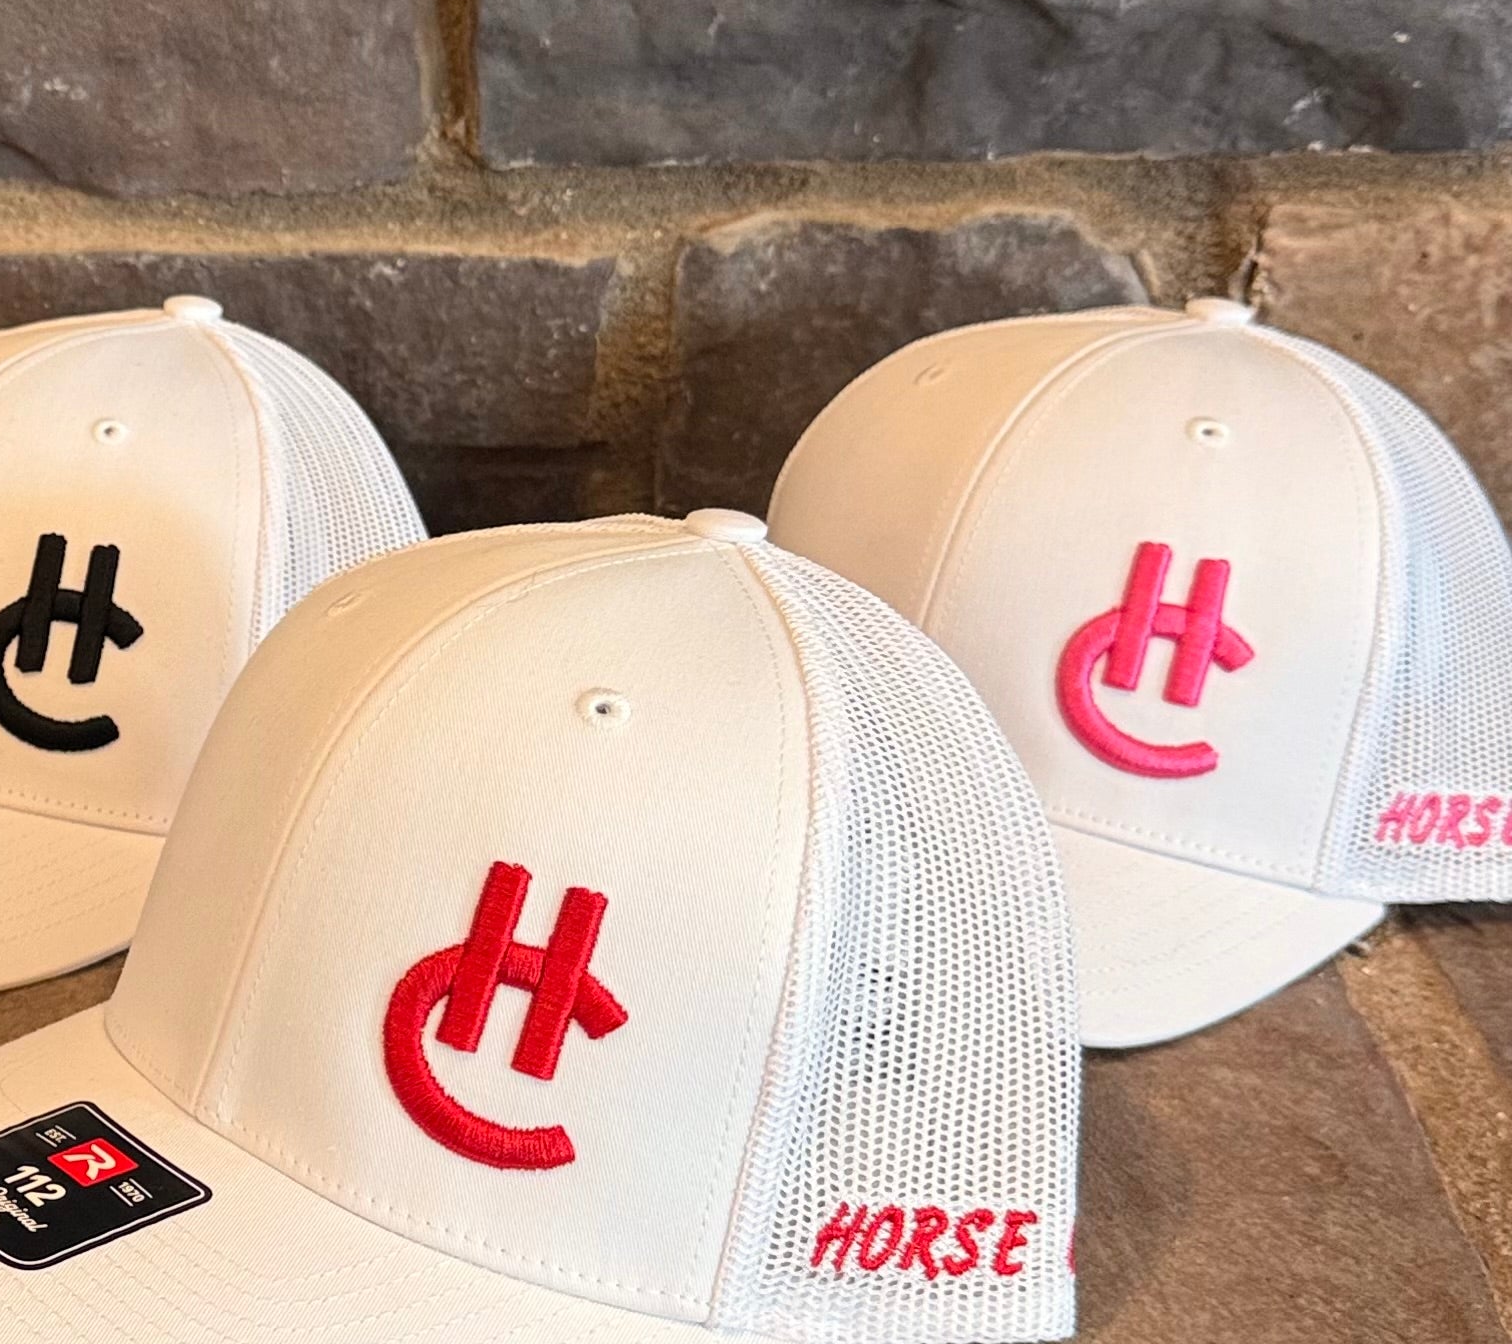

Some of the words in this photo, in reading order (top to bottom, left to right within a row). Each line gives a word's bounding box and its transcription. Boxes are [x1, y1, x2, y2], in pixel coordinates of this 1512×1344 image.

[61, 1143, 117, 1181] R
[3, 1165, 67, 1208] 112
[117, 1181, 146, 1203] 1970
[810, 1201, 1039, 1281] HORSE
